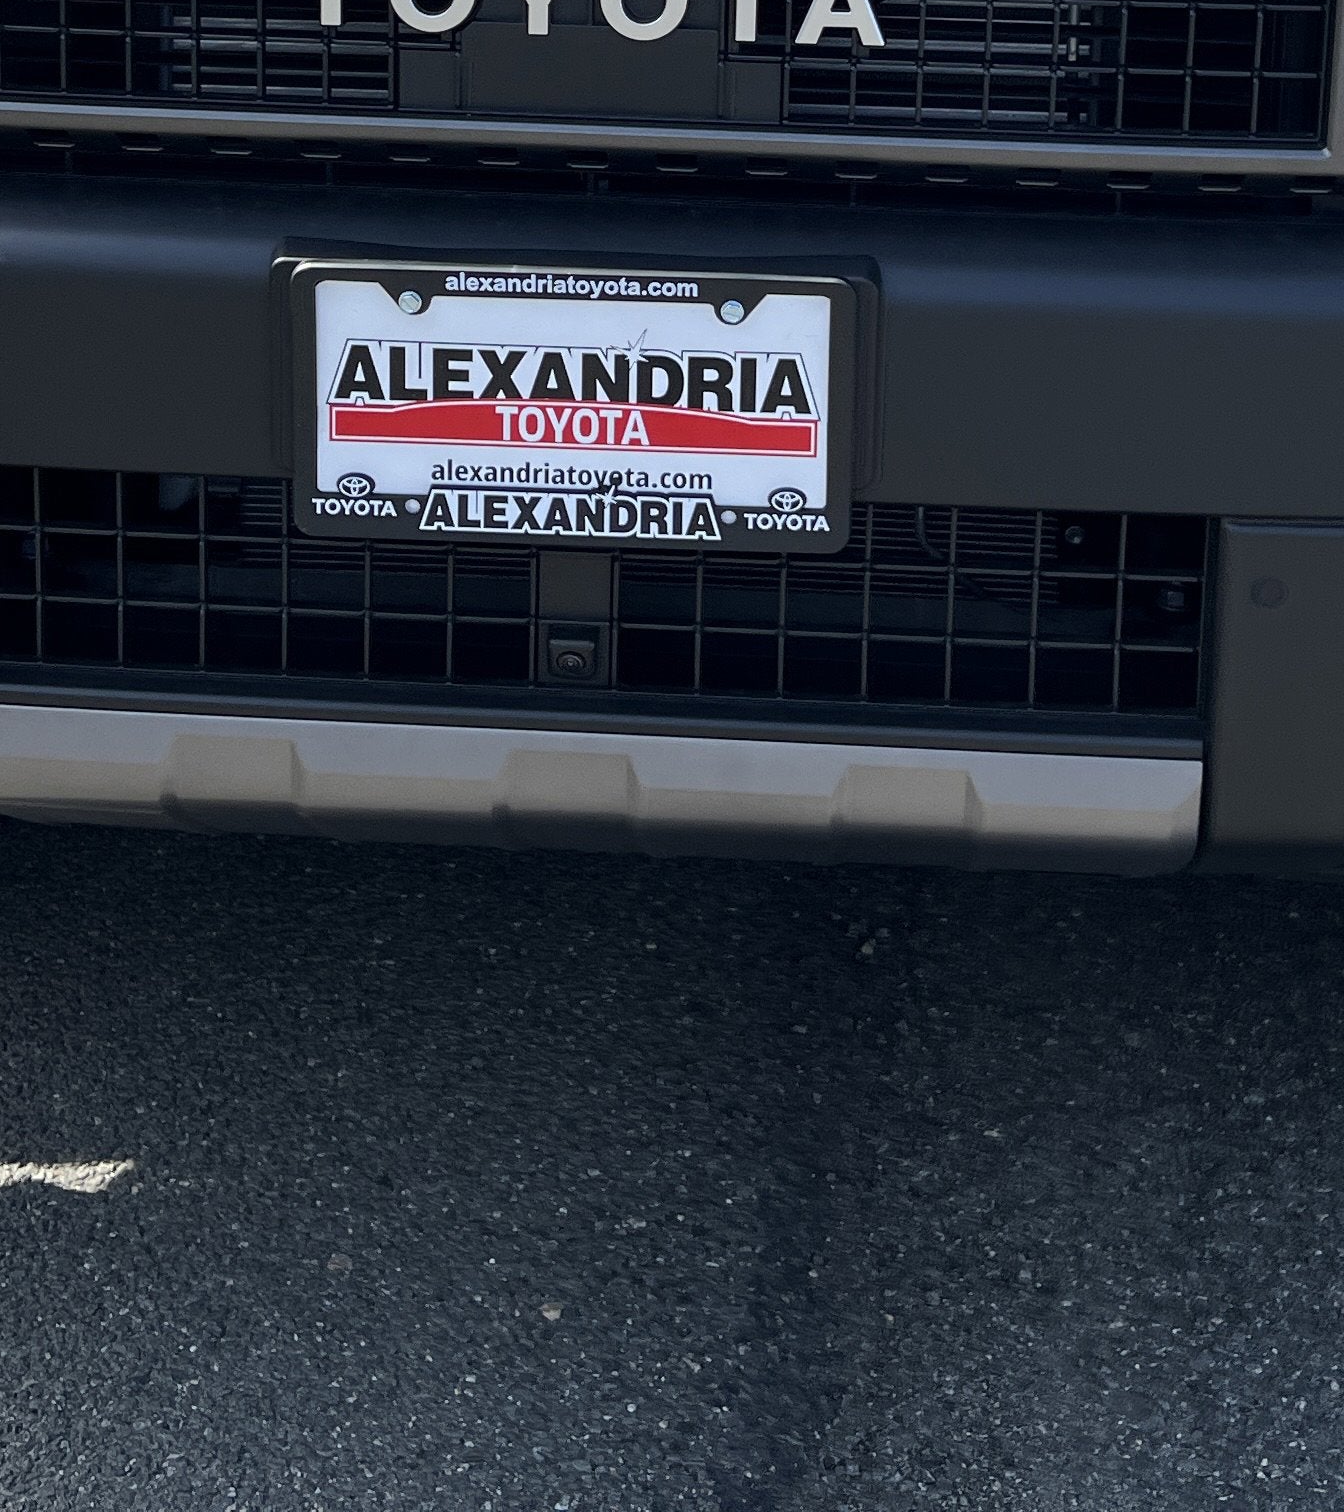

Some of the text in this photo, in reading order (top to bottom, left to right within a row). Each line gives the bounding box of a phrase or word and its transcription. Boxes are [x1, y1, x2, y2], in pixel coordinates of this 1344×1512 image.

[444, 271, 699, 298] alexandriatoyota.com
[330, 341, 815, 418] ALEXANDRIA
[495, 405, 650, 447] TOYOTA
[430, 459, 713, 490] alexandriatoyota.com
[312, 488, 830, 541] TOYOTA ALEXANDRIA TOYOTA
